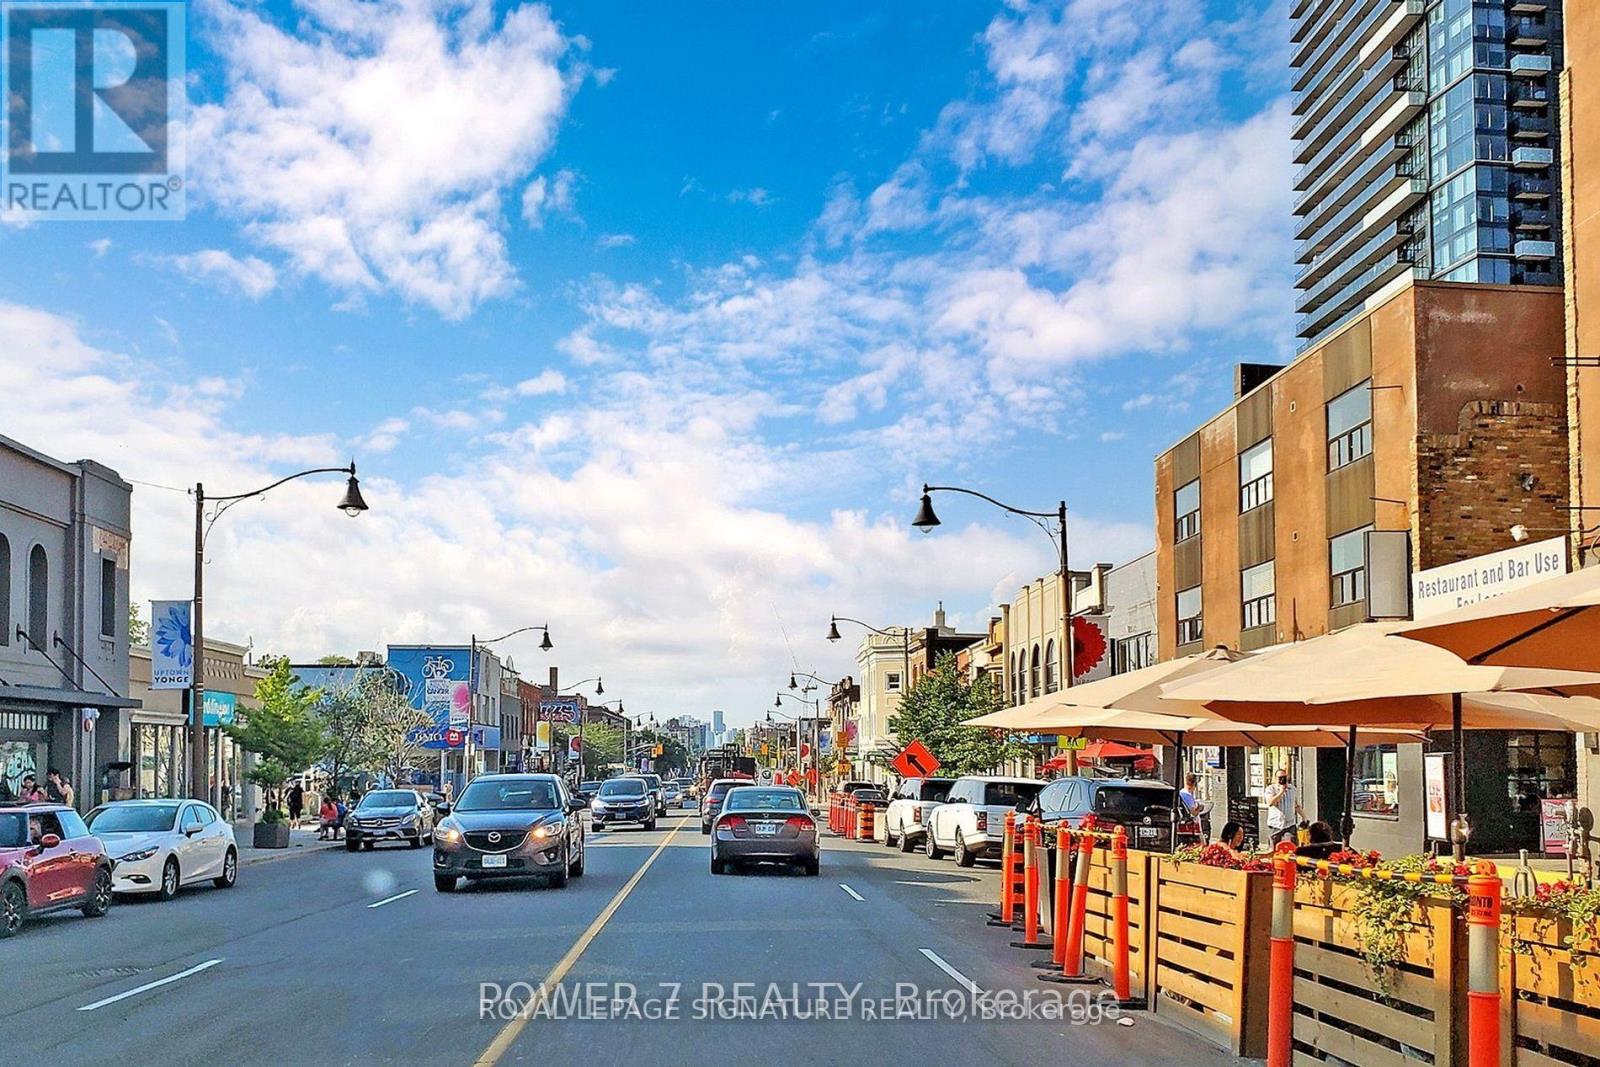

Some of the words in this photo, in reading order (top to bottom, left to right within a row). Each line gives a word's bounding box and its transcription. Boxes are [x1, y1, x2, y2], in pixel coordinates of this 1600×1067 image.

[1418, 568, 1479, 599] Restaurant
[1482, 563, 1504, 585] and
[1508, 559, 1529, 580] Bar
[1534, 552, 1559, 574] Use
